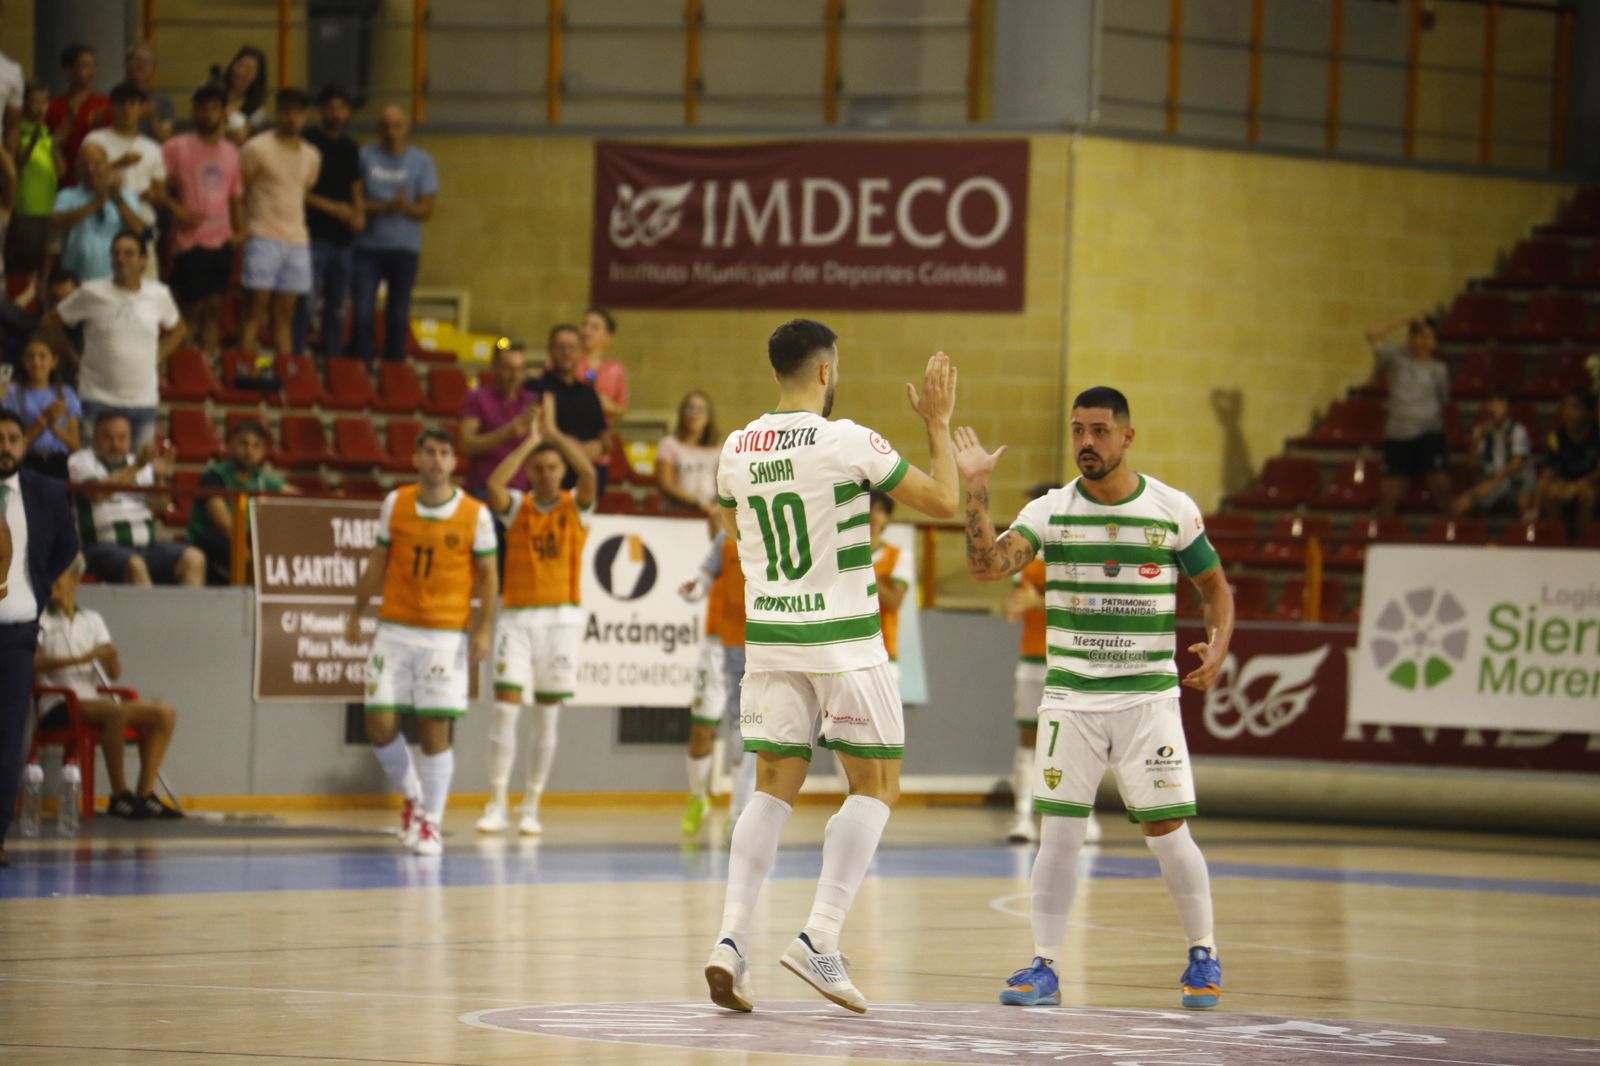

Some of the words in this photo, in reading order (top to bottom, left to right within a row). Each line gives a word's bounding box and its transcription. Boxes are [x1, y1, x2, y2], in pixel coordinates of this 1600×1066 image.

[701, 176, 1012, 249] IMDECO
[609, 261, 689, 284] Instituto
[693, 261, 787, 287] Municipal
[792, 261, 818, 283] de
[823, 261, 914, 288] Deportes
[918, 261, 1007, 286] Córdoba
[749, 458, 795, 485] SAURA
[747, 491, 812, 582] 10
[265, 554, 289, 586] LA
[291, 550, 356, 587] SARTÉN
[412, 545, 435, 580] 11
[753, 592, 826, 613] MONTILLA
[1101, 606, 1156, 616] HUMANIDAD
[1102, 598, 1152, 607] PATRIMONIO
[584, 612, 699, 654] Arcángel
[1072, 635, 1136, 650] Mezquita-
[1485, 602, 1600, 654] Sier
[1088, 650, 1148, 662] Catedral
[1047, 720, 1060, 757] 7
